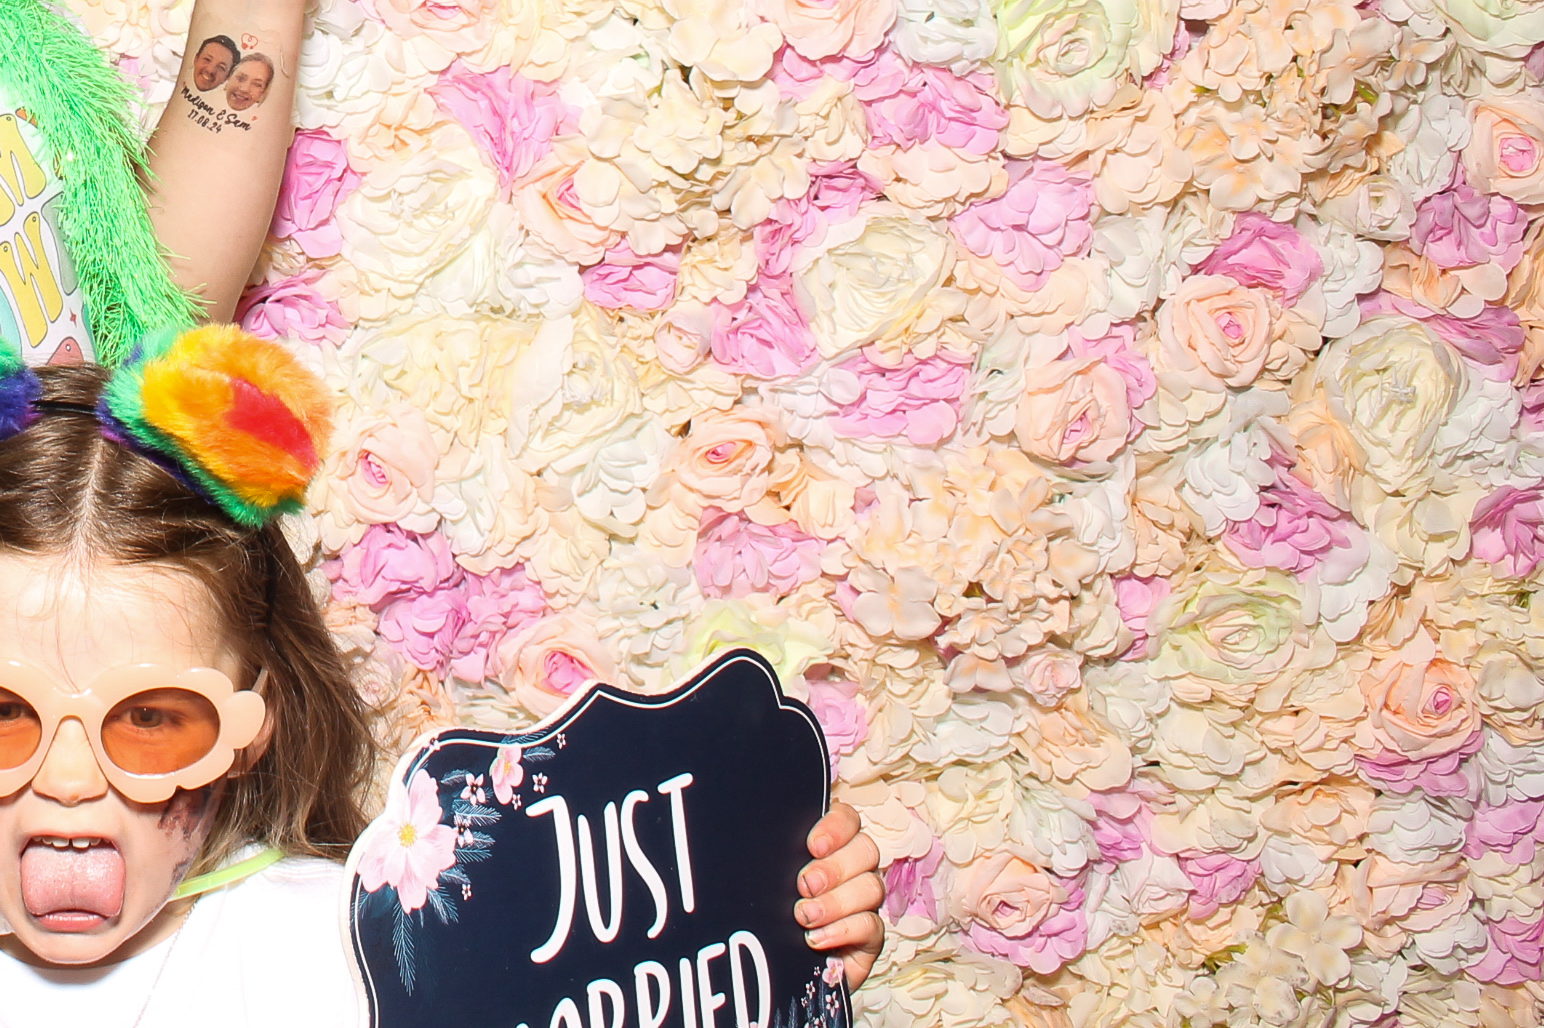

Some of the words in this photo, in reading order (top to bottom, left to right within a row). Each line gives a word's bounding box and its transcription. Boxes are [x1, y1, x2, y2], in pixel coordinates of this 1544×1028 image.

[187, 109, 223, 134] 17.08.24
[224, 113, 253, 132] Sam
[525, 772, 695, 964] JUST
